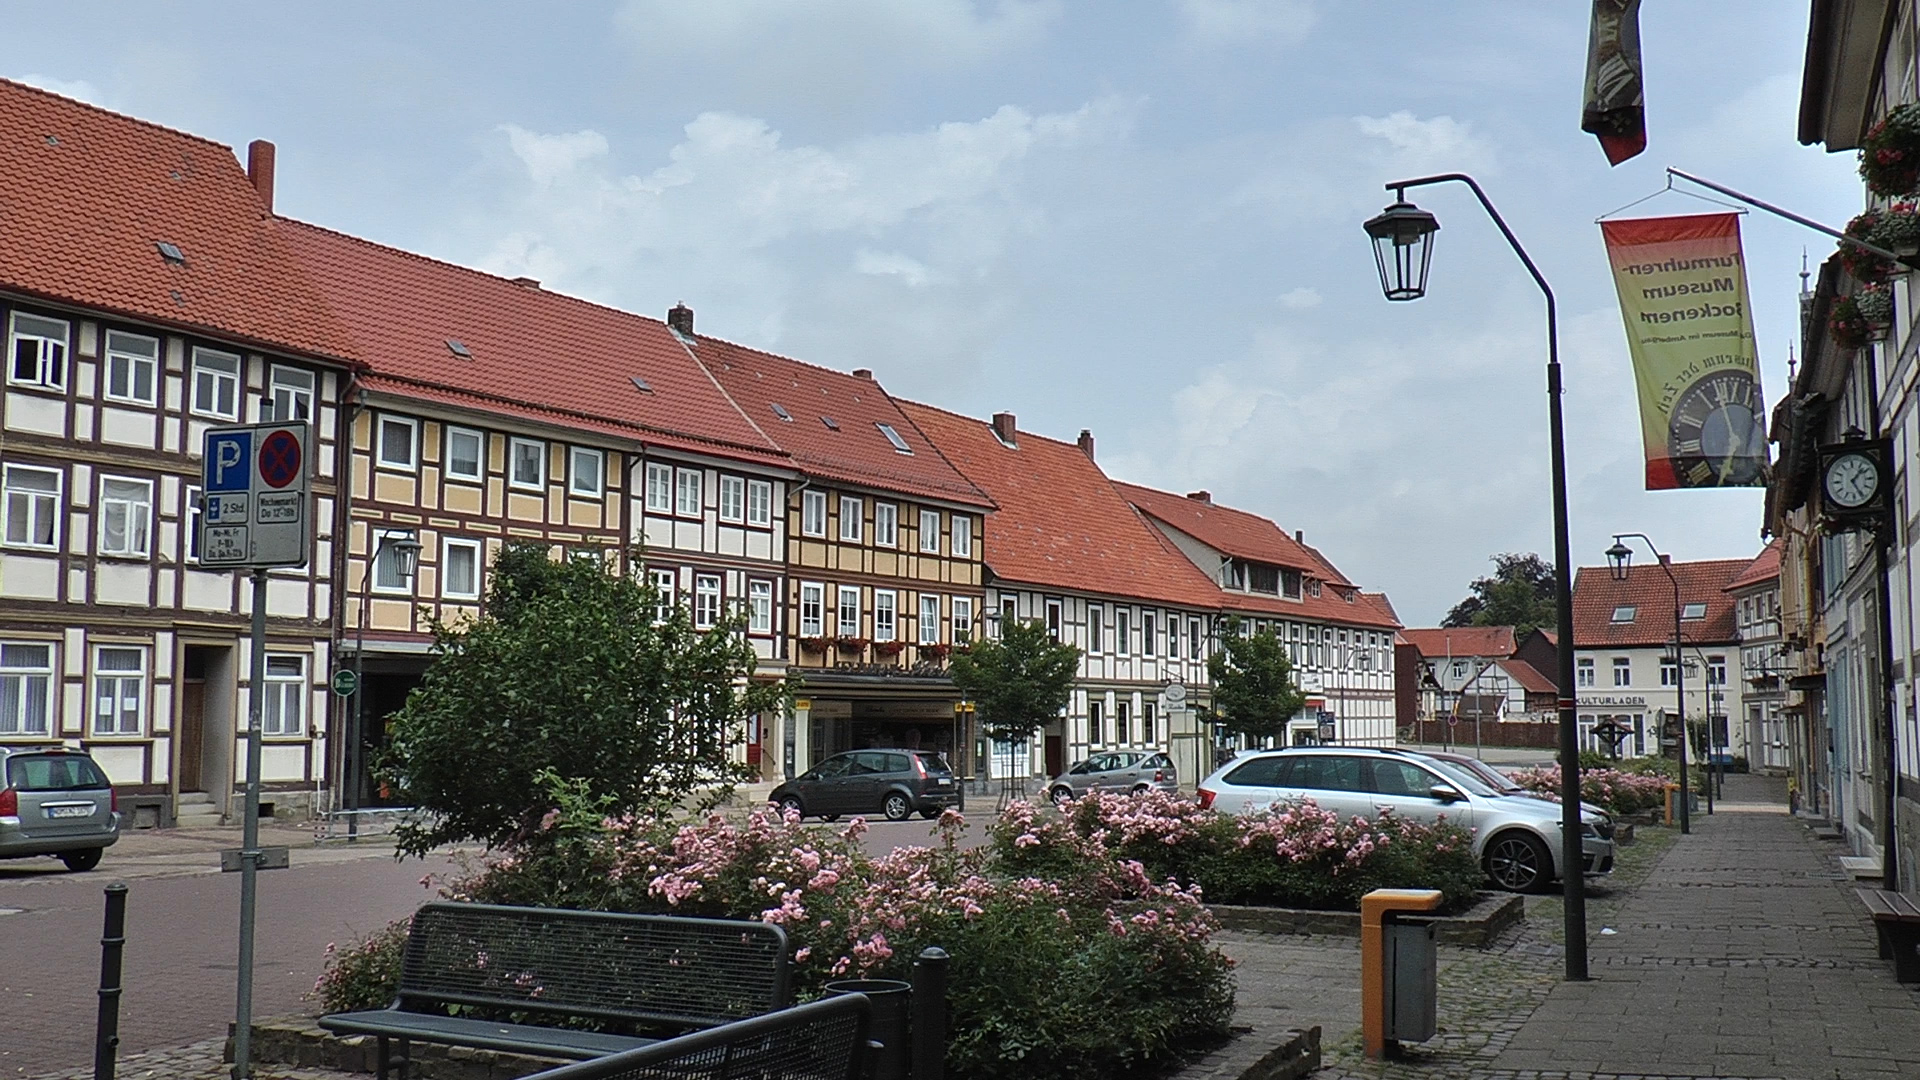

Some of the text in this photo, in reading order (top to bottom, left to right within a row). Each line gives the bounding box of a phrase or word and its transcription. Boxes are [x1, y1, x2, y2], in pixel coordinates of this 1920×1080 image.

[216, 440, 241, 485] P
[223, 503, 229, 514] 2
[1575, 696, 1645, 705] KULTURLADEN
